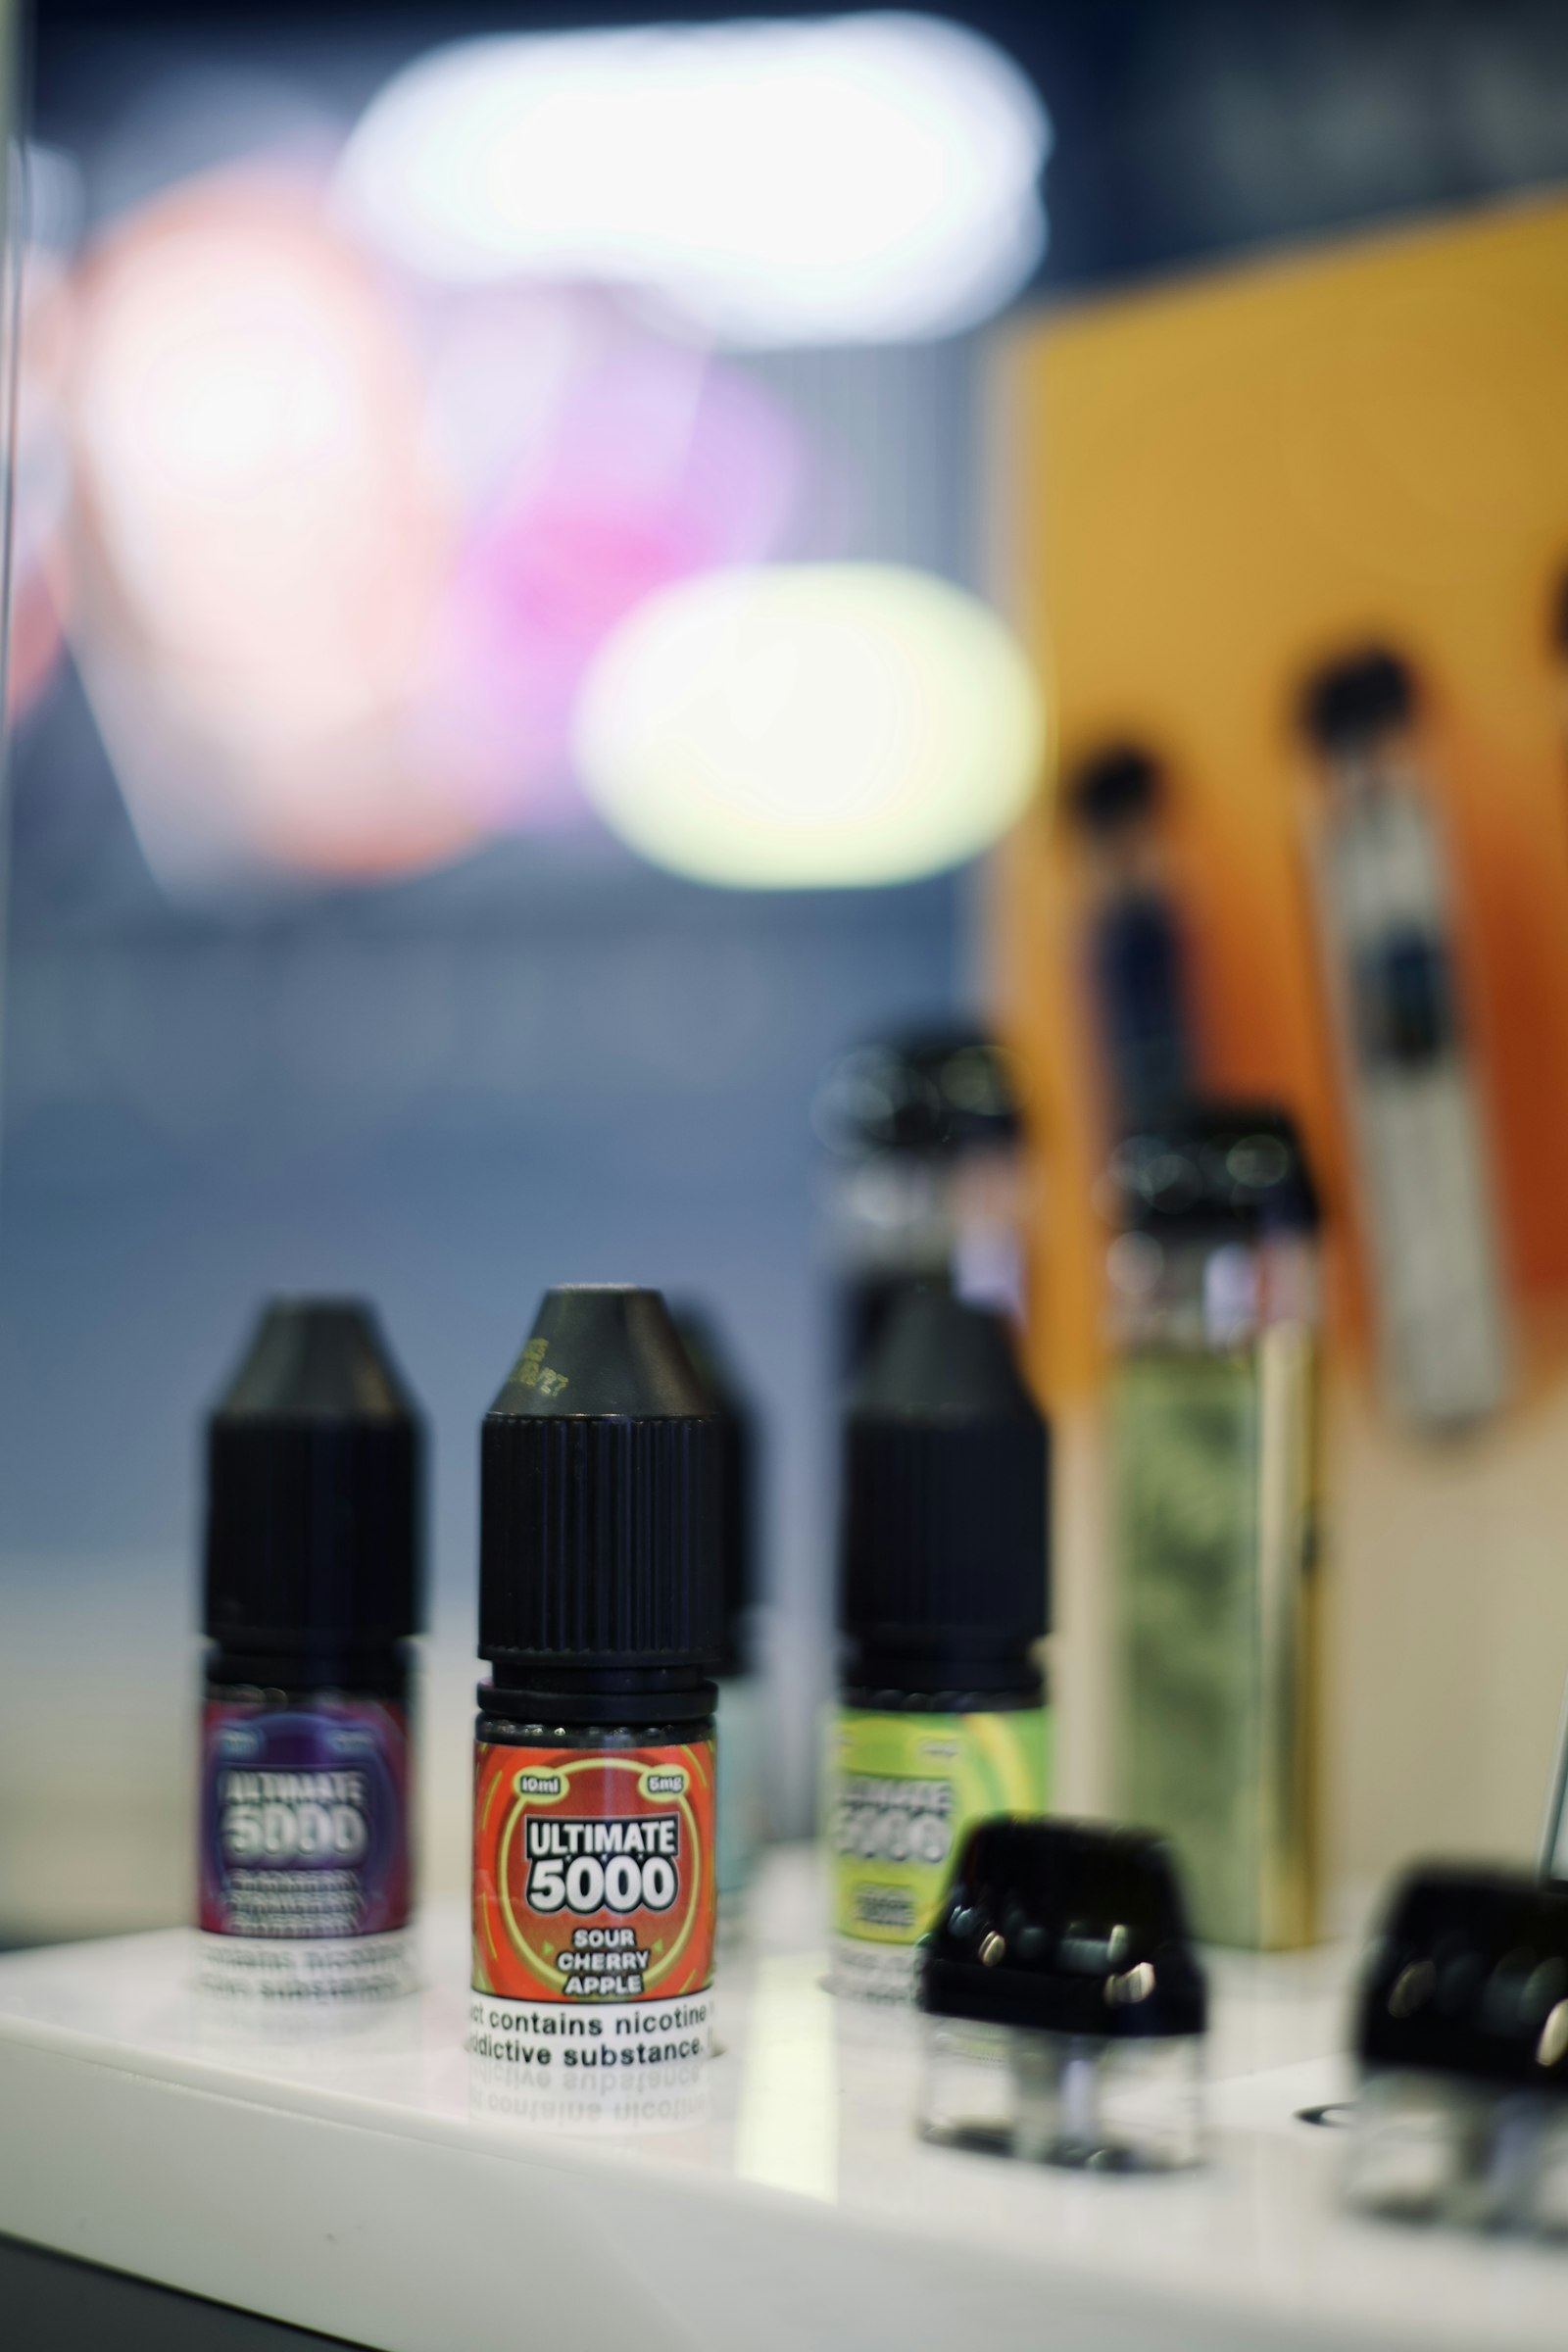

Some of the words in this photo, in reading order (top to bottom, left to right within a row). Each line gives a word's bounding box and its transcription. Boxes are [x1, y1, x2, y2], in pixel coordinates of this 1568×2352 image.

[521, 1776, 560, 1794] 10ml
[221, 1802, 369, 1863] 5000
[529, 1820, 676, 1856] ULTIMATE
[528, 1854, 676, 1912] 5000
[573, 1928, 635, 1948] SOUR
[557, 1949, 649, 1972] CHERRY
[564, 1975, 642, 1995] APPLE
[490, 2010, 603, 2035] contains
[615, 2004, 707, 2034] nicotine
[470, 2031, 552, 2065] ddictive
[564, 2037, 704, 2067] substance.
